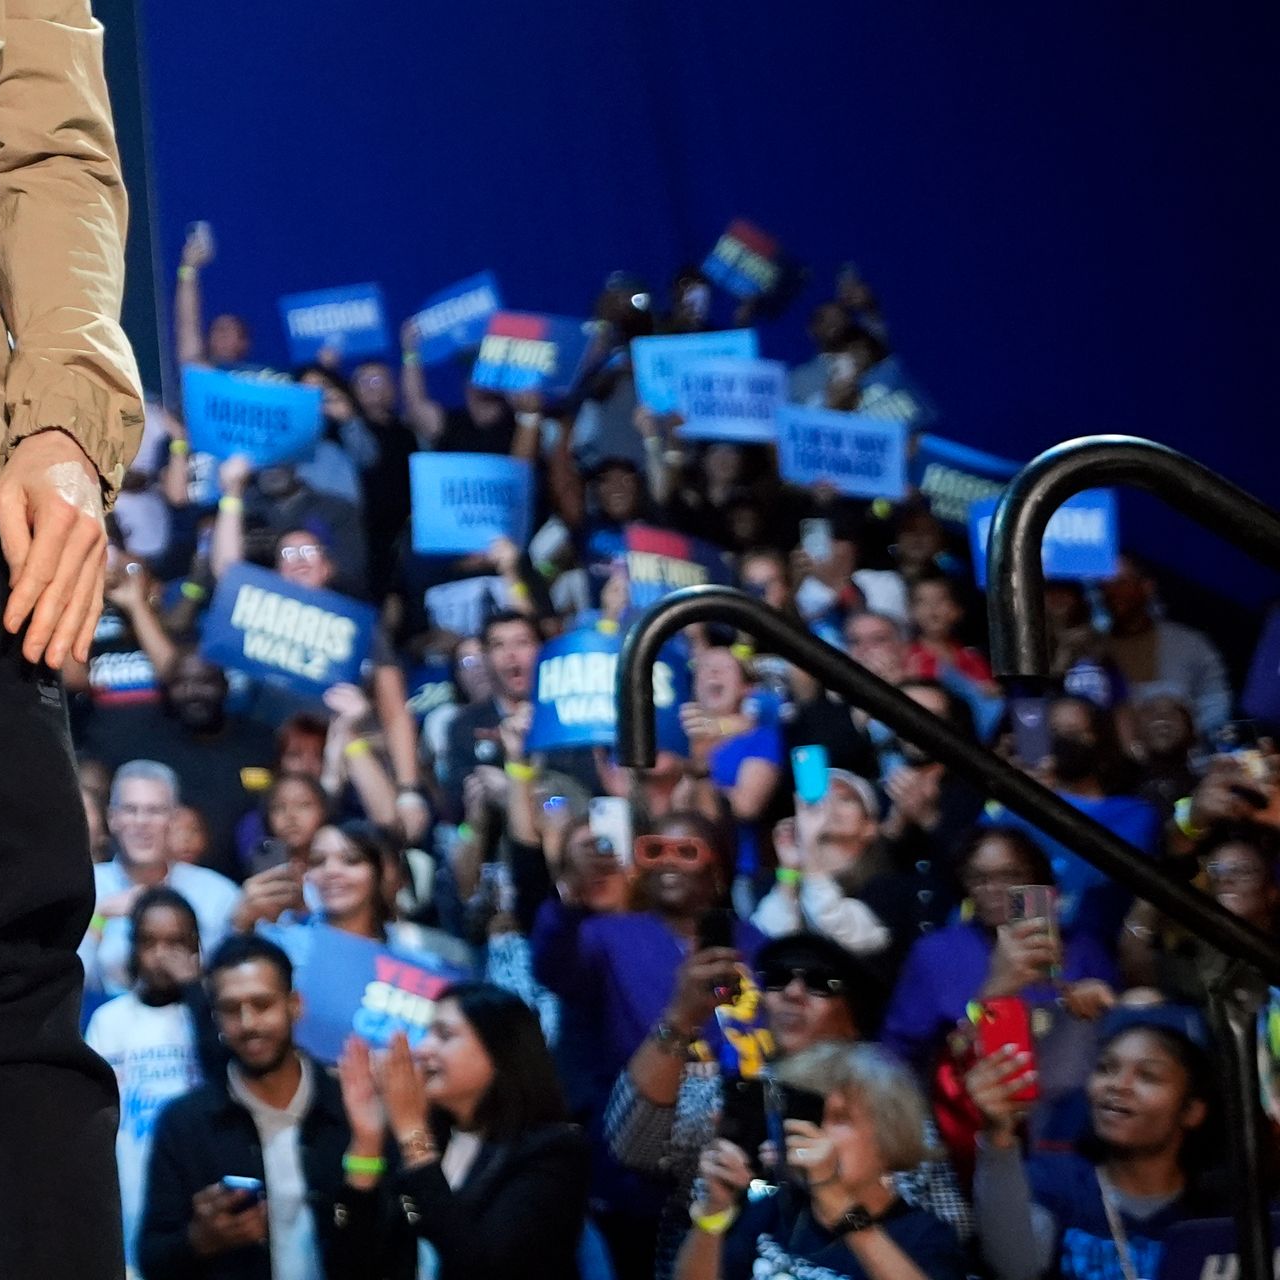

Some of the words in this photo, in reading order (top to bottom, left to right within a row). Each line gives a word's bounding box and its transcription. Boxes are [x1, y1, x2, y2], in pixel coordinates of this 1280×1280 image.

[204, 394, 290, 433] HARRIS
[230, 583, 357, 663] HARRIS
[242, 629, 327, 682] WALZ
